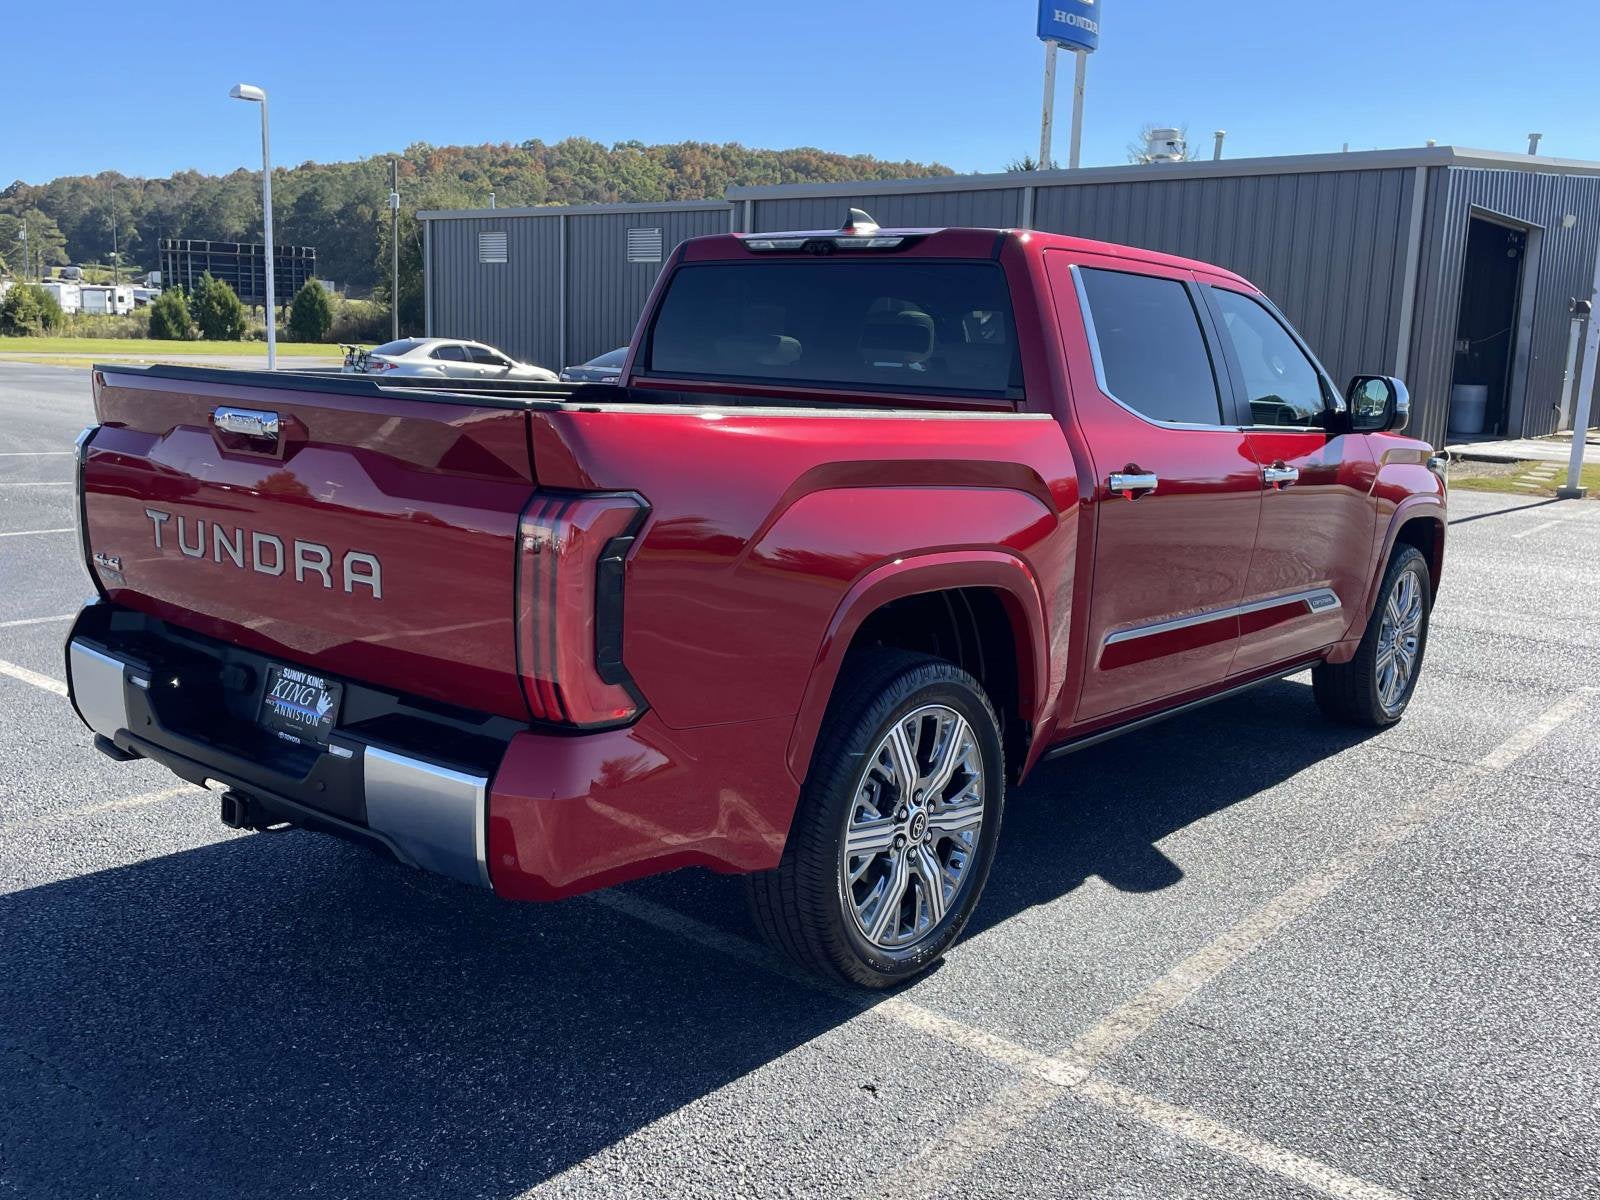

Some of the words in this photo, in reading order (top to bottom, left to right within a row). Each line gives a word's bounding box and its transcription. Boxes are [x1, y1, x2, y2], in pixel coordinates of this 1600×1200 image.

[1053, 9, 1098, 35] HONDA
[145, 507, 383, 599] TUNDRA
[282, 667, 307, 683] SUNNY
[306, 675, 325, 690] KING
[270, 678, 315, 706] KING
[273, 703, 320, 727] ANNISTON
[284, 733, 301, 744] TOYOTA
